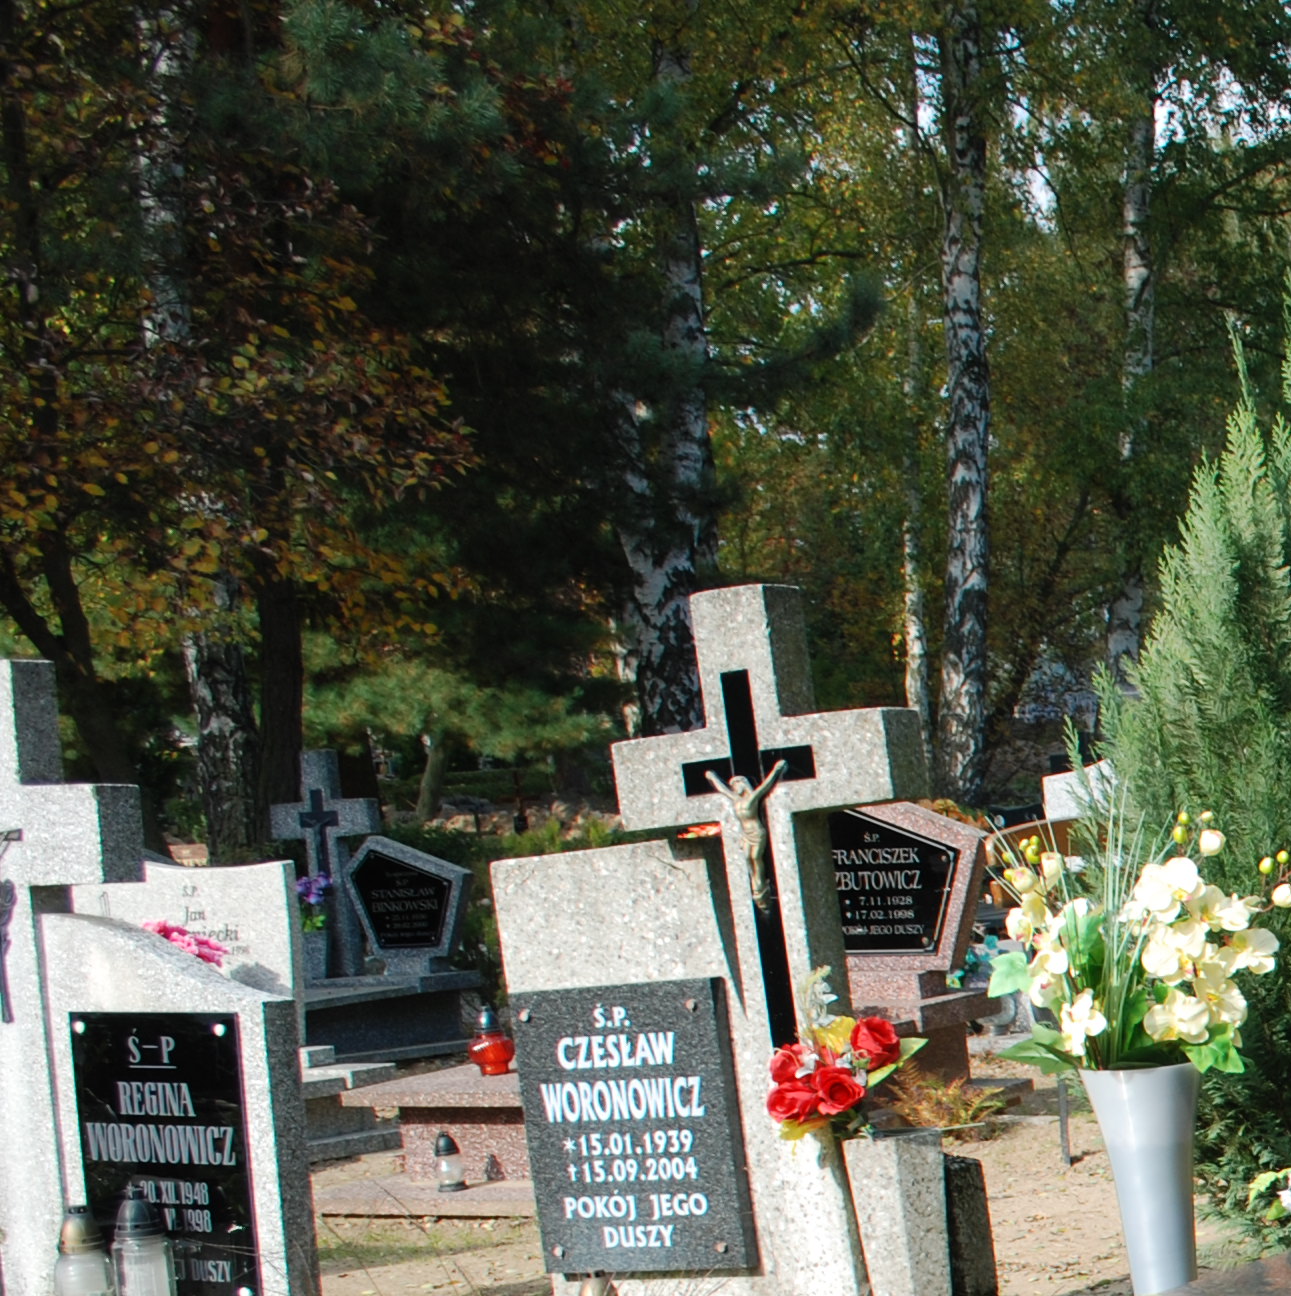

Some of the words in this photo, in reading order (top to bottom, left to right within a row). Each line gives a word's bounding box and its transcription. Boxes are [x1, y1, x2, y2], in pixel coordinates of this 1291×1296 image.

[592, 1003, 631, 1028] Ś.P.
[556, 1031, 675, 1070] CZESŁAW
[117, 1081, 196, 1118] REGINA
[540, 1076, 706, 1123] WORONOWICZ
[86, 1122, 237, 1167] WORONOWICZ
[563, 1189, 637, 1221] POKÓJ
[652, 1192, 709, 1221] JEGO
[603, 1224, 675, 1249] DUSZY
[191, 1259, 231, 1282] DUSZY
